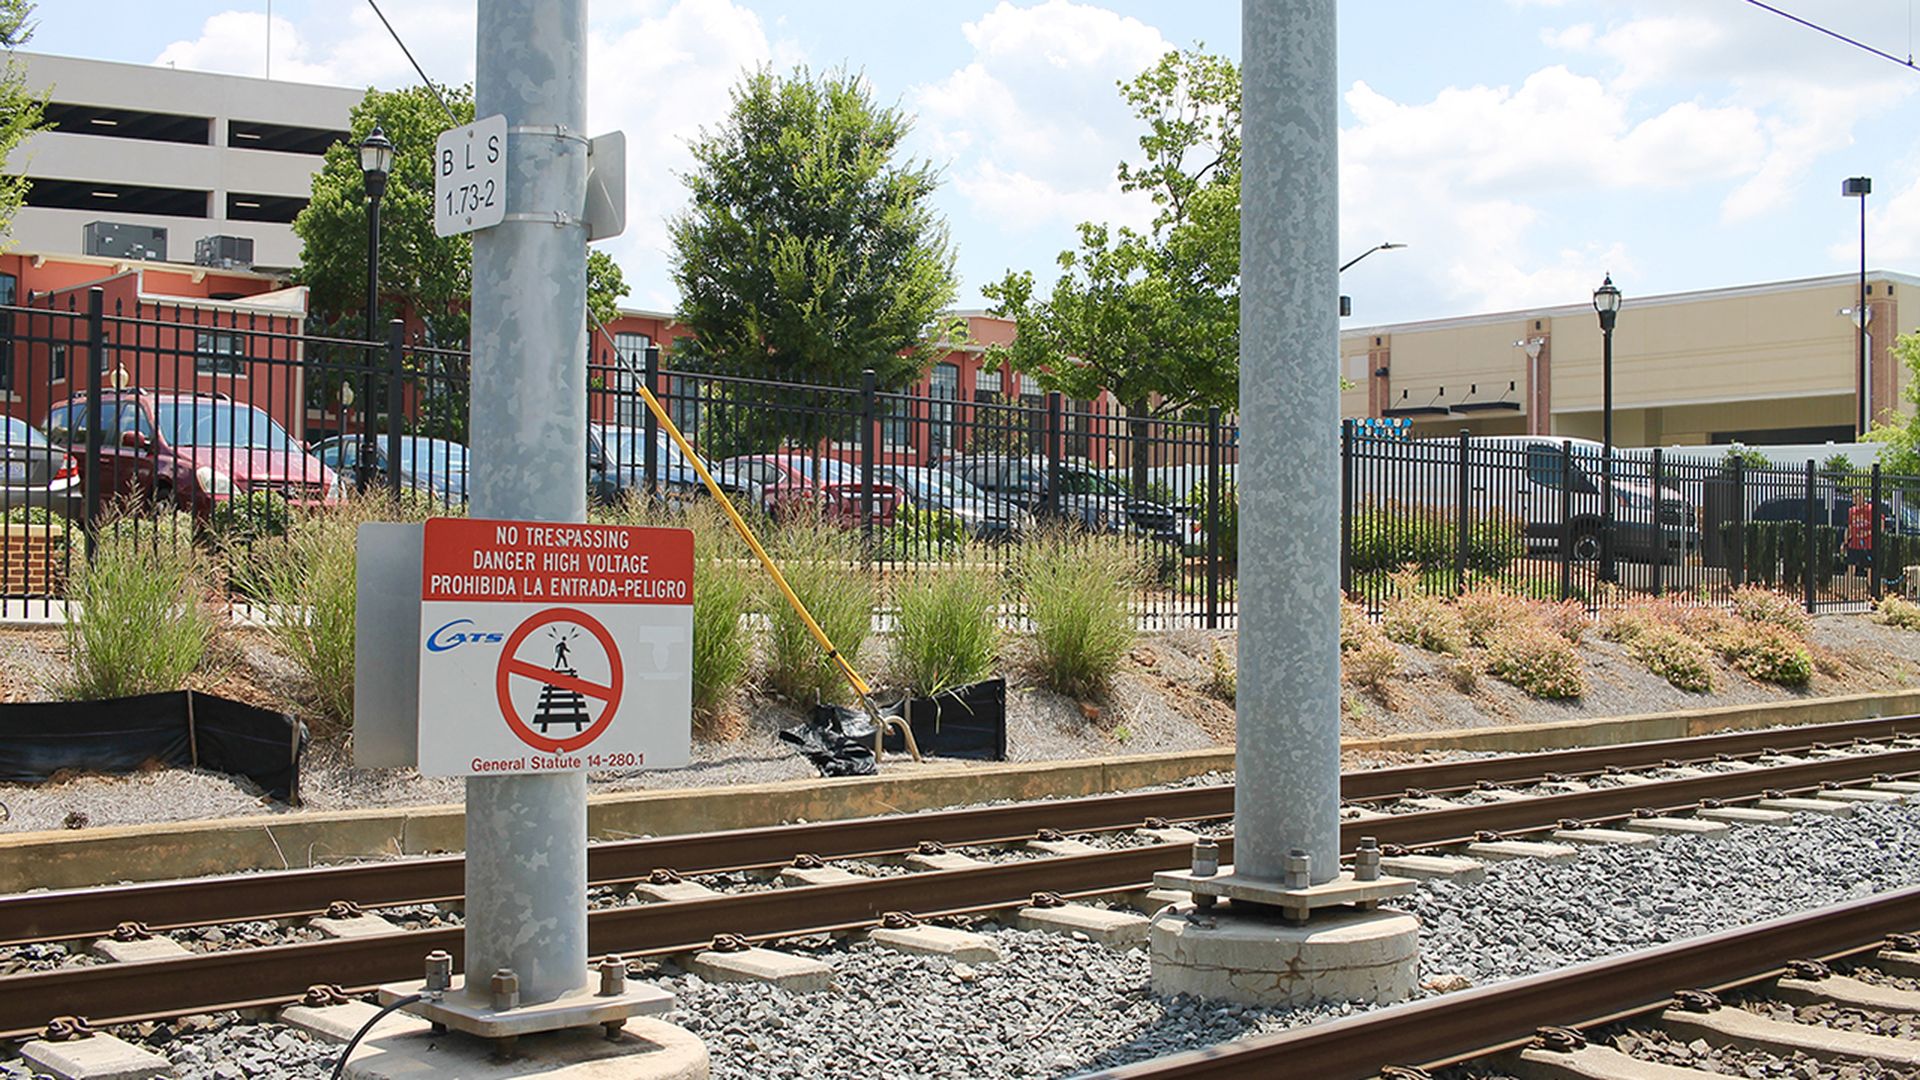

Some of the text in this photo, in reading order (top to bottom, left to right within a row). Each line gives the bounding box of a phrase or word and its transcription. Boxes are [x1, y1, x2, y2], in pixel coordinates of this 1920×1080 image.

[442, 136, 499, 176] B L S
[446, 179, 495, 216] 1.73-2
[496, 526, 630, 549] NO TRESPASSING
[473, 551, 649, 574] DANGER HIGH VOLTAGE
[430, 575, 687, 599] PROHIBIDA LA ENTRADA-PELIGRO
[471, 754, 645, 772] General Statute 14-280.1
